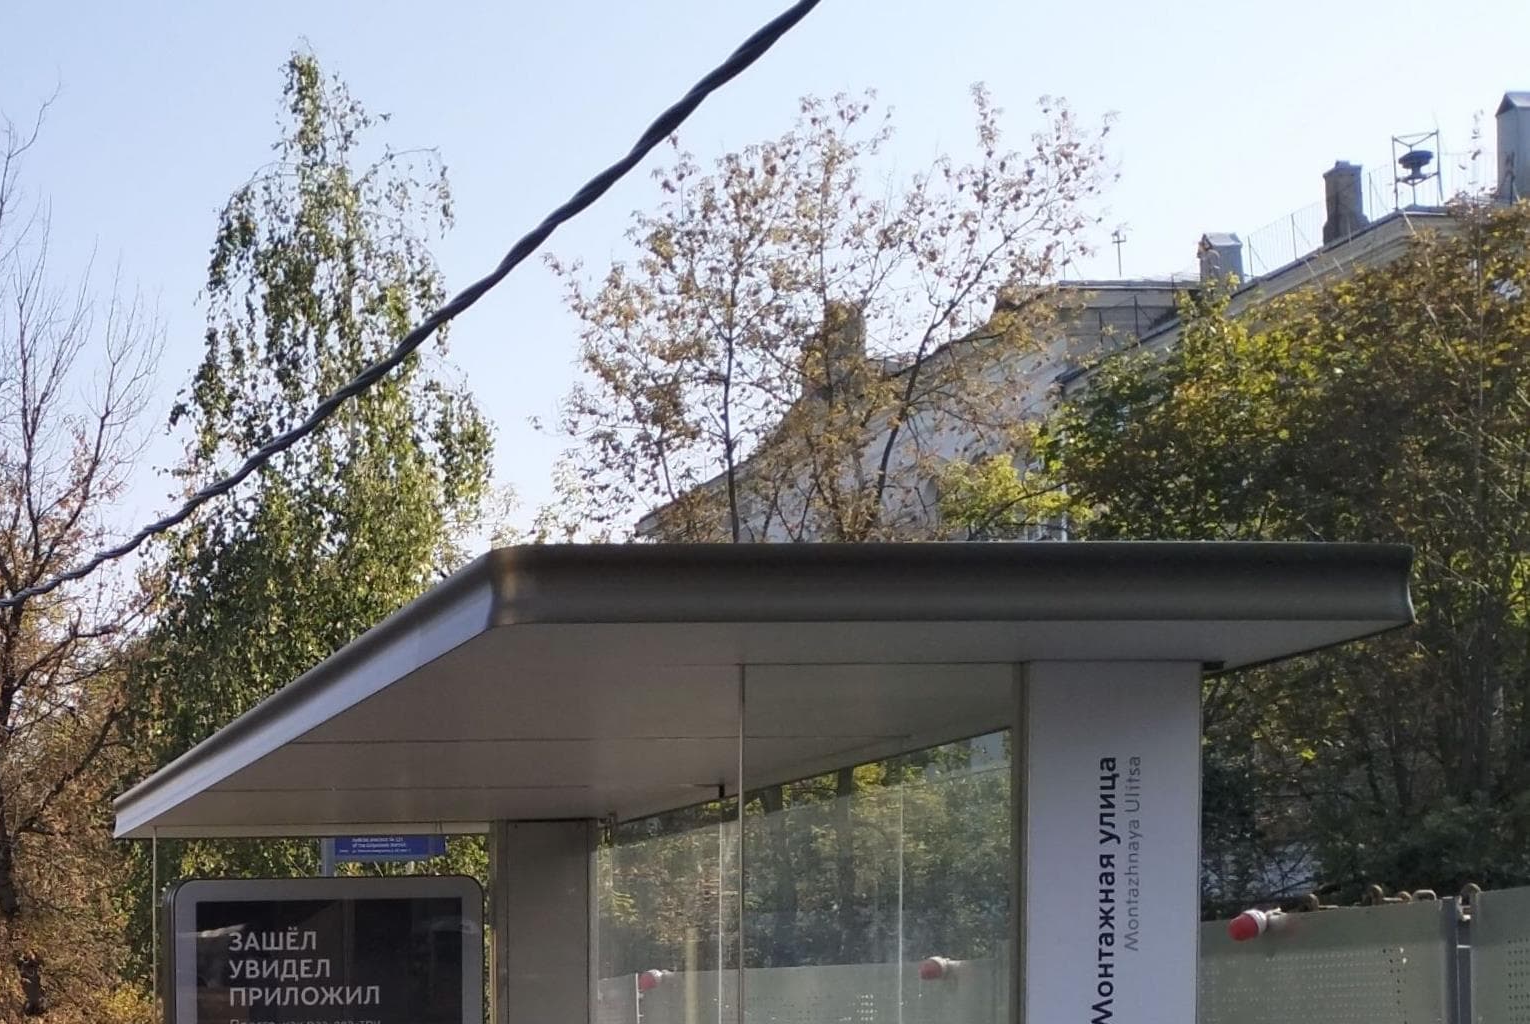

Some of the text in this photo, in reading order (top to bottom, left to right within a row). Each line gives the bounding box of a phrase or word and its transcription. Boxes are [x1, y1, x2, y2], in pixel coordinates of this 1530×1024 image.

[1099, 757, 1120, 845] улица
[1124, 755, 1143, 951] Montazhnaya Ulitsa
[228, 926, 317, 952] ЗАШЁЛ
[228, 958, 331, 983] УВИДЕЛ
[229, 985, 381, 1007] ПРИЛОЖИЛ
